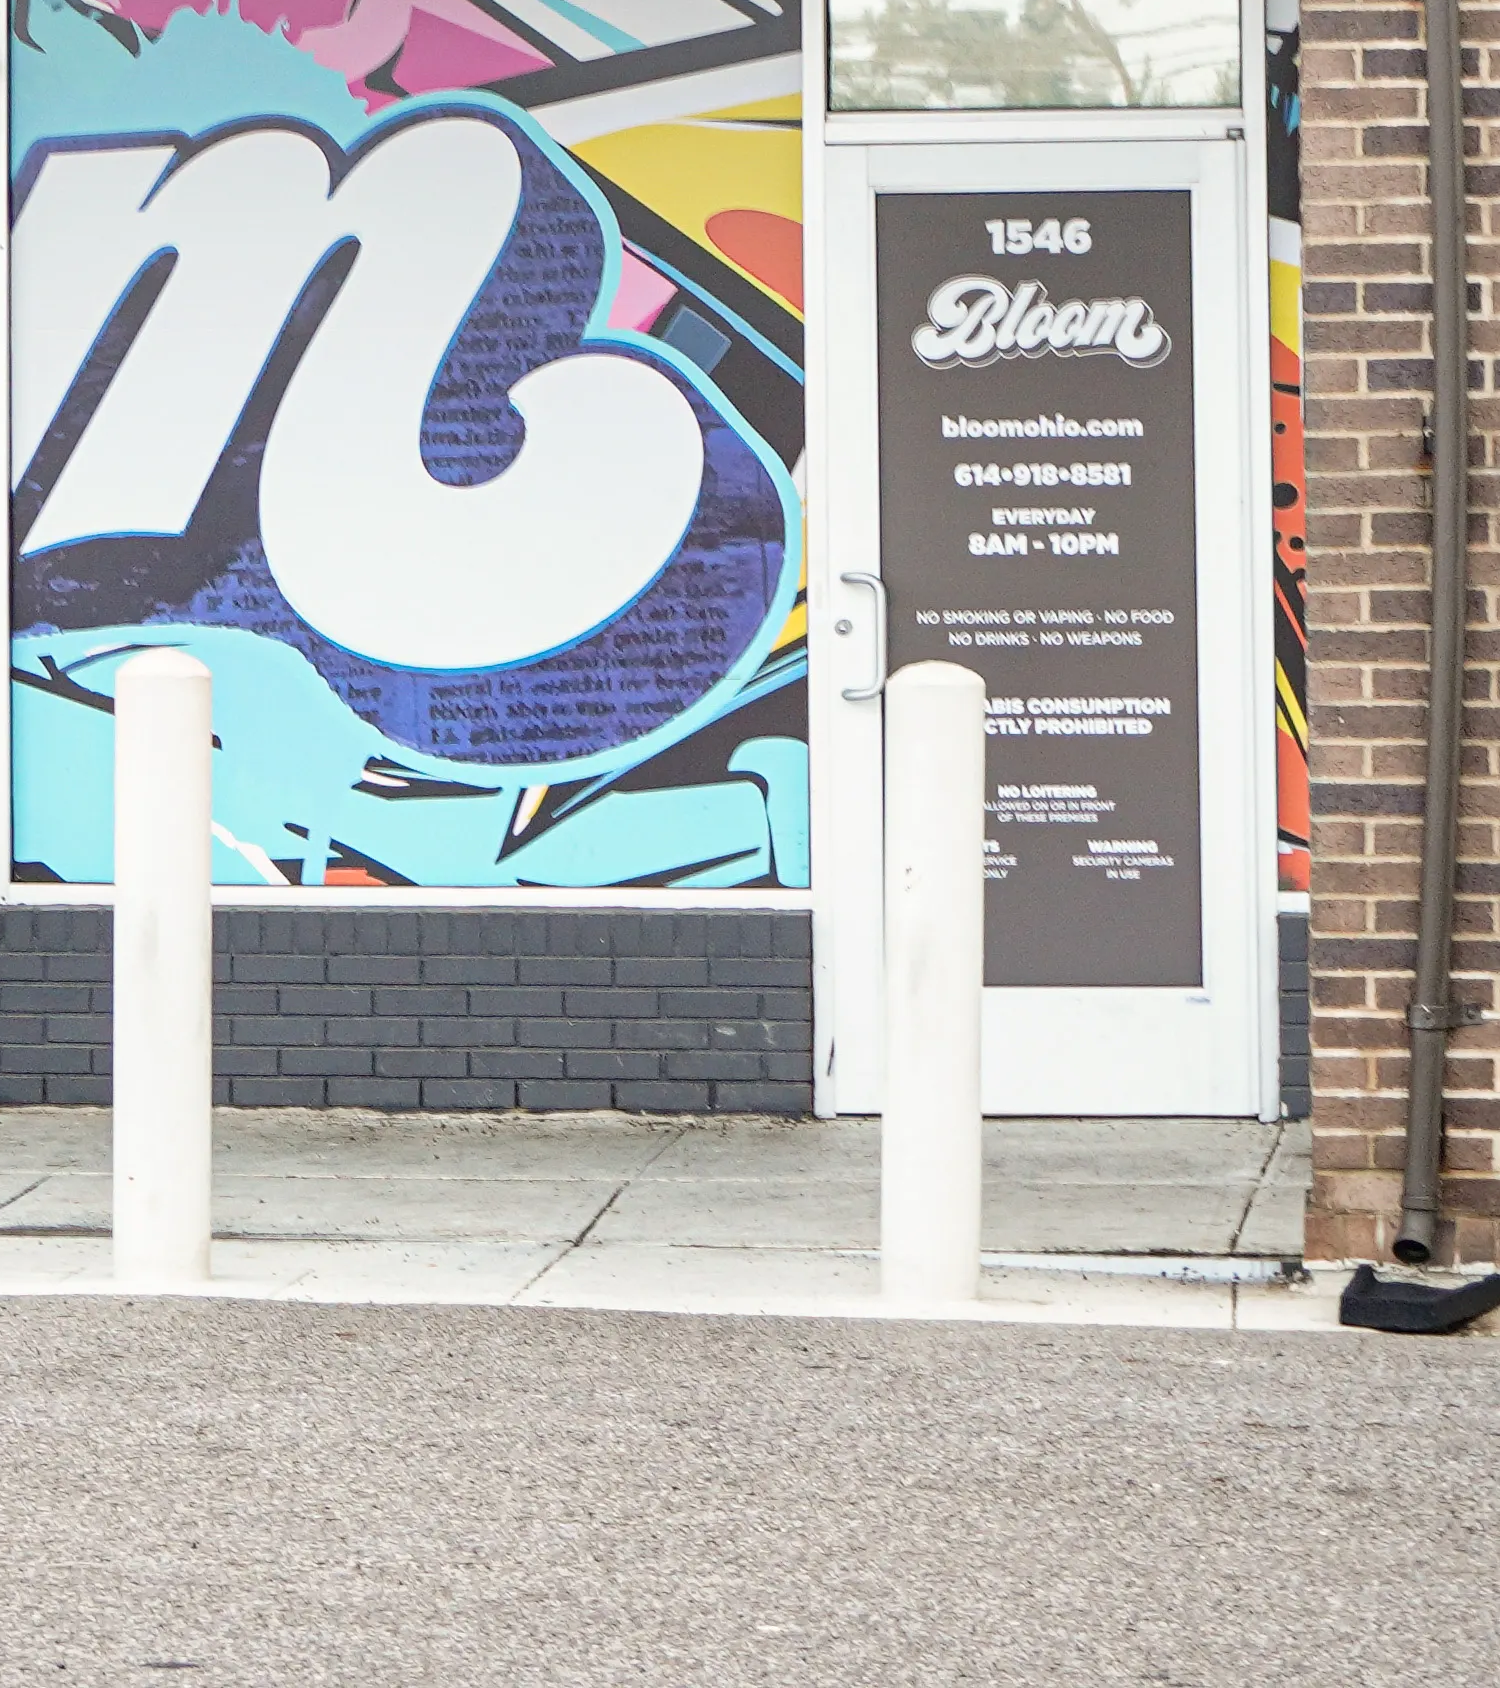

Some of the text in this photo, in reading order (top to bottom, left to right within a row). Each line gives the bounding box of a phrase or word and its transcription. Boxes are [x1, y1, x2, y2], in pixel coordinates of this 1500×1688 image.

[985, 217, 1093, 254] 1546
[911, 274, 1172, 369] Bloom
[941, 413, 1145, 438] bloomohio.com
[991, 507, 1097, 525] EVERYDAY
[968, 532, 1028, 555] 8AM
[1048, 532, 1119, 555] 10PM
[916, 610, 1174, 625] NO SMOKING OR VAPING NO FOOD
[949, 631, 1143, 645] NO DRINKS NO WEAPONS
[1027, 697, 1171, 714] CONSUMPTION
[1035, 718, 1153, 734] PROHIBITED
[997, 785, 1097, 798] NO LOITERING
[1082, 800, 1116, 811] FRONT
[997, 813, 1098, 823] OF THESE PREMISES
[1087, 840, 1158, 853] WARNING
[1072, 855, 1175, 867] SECURITY CAMERAS
[1105, 869, 1140, 880] IN USE
